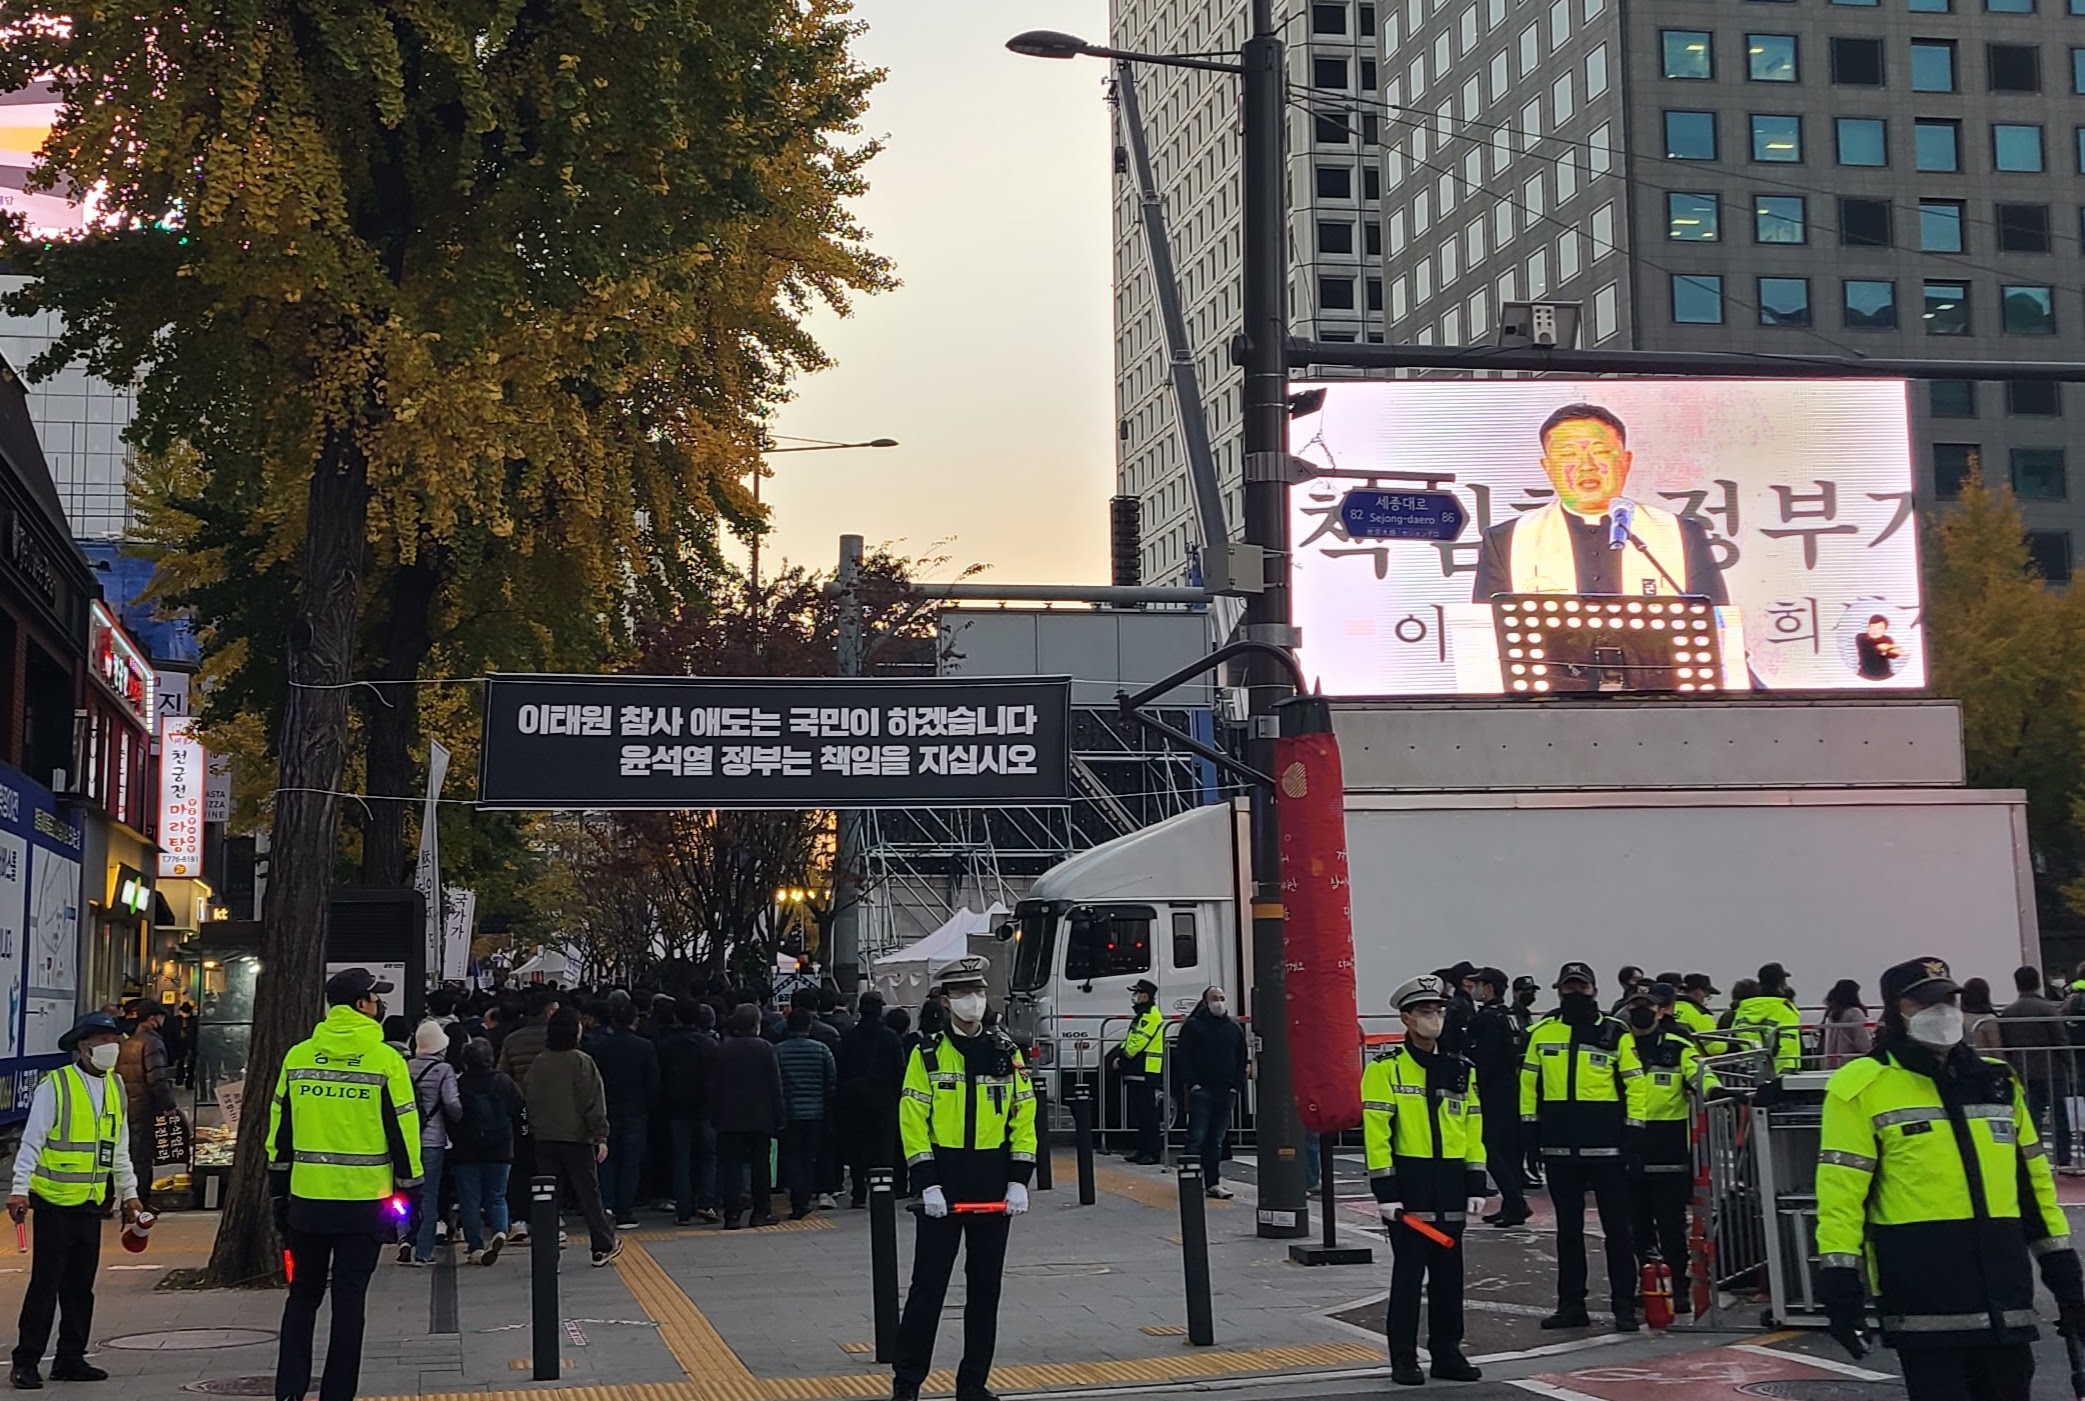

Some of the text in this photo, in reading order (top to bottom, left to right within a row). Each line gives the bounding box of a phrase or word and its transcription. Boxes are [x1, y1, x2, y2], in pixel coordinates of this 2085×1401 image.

[1375, 495, 1429, 512] 세종대로
[1350, 508, 1364, 520] 82
[1369, 513, 1436, 525] Sejong-daero
[1441, 511, 1455, 523] 86
[518, 704, 1038, 737] 이태원 참사 애도는 국민이 하겠습니다
[619, 744, 1038, 776] 윤석열 정부는 책임을 지십시오
[206, 790, 226, 798] ASTA
[206, 800, 226, 809] IZZA
[168, 803, 188, 853] 마라탕
[213, 907, 228, 920] kt
[299, 1084, 371, 1100] POLICE
